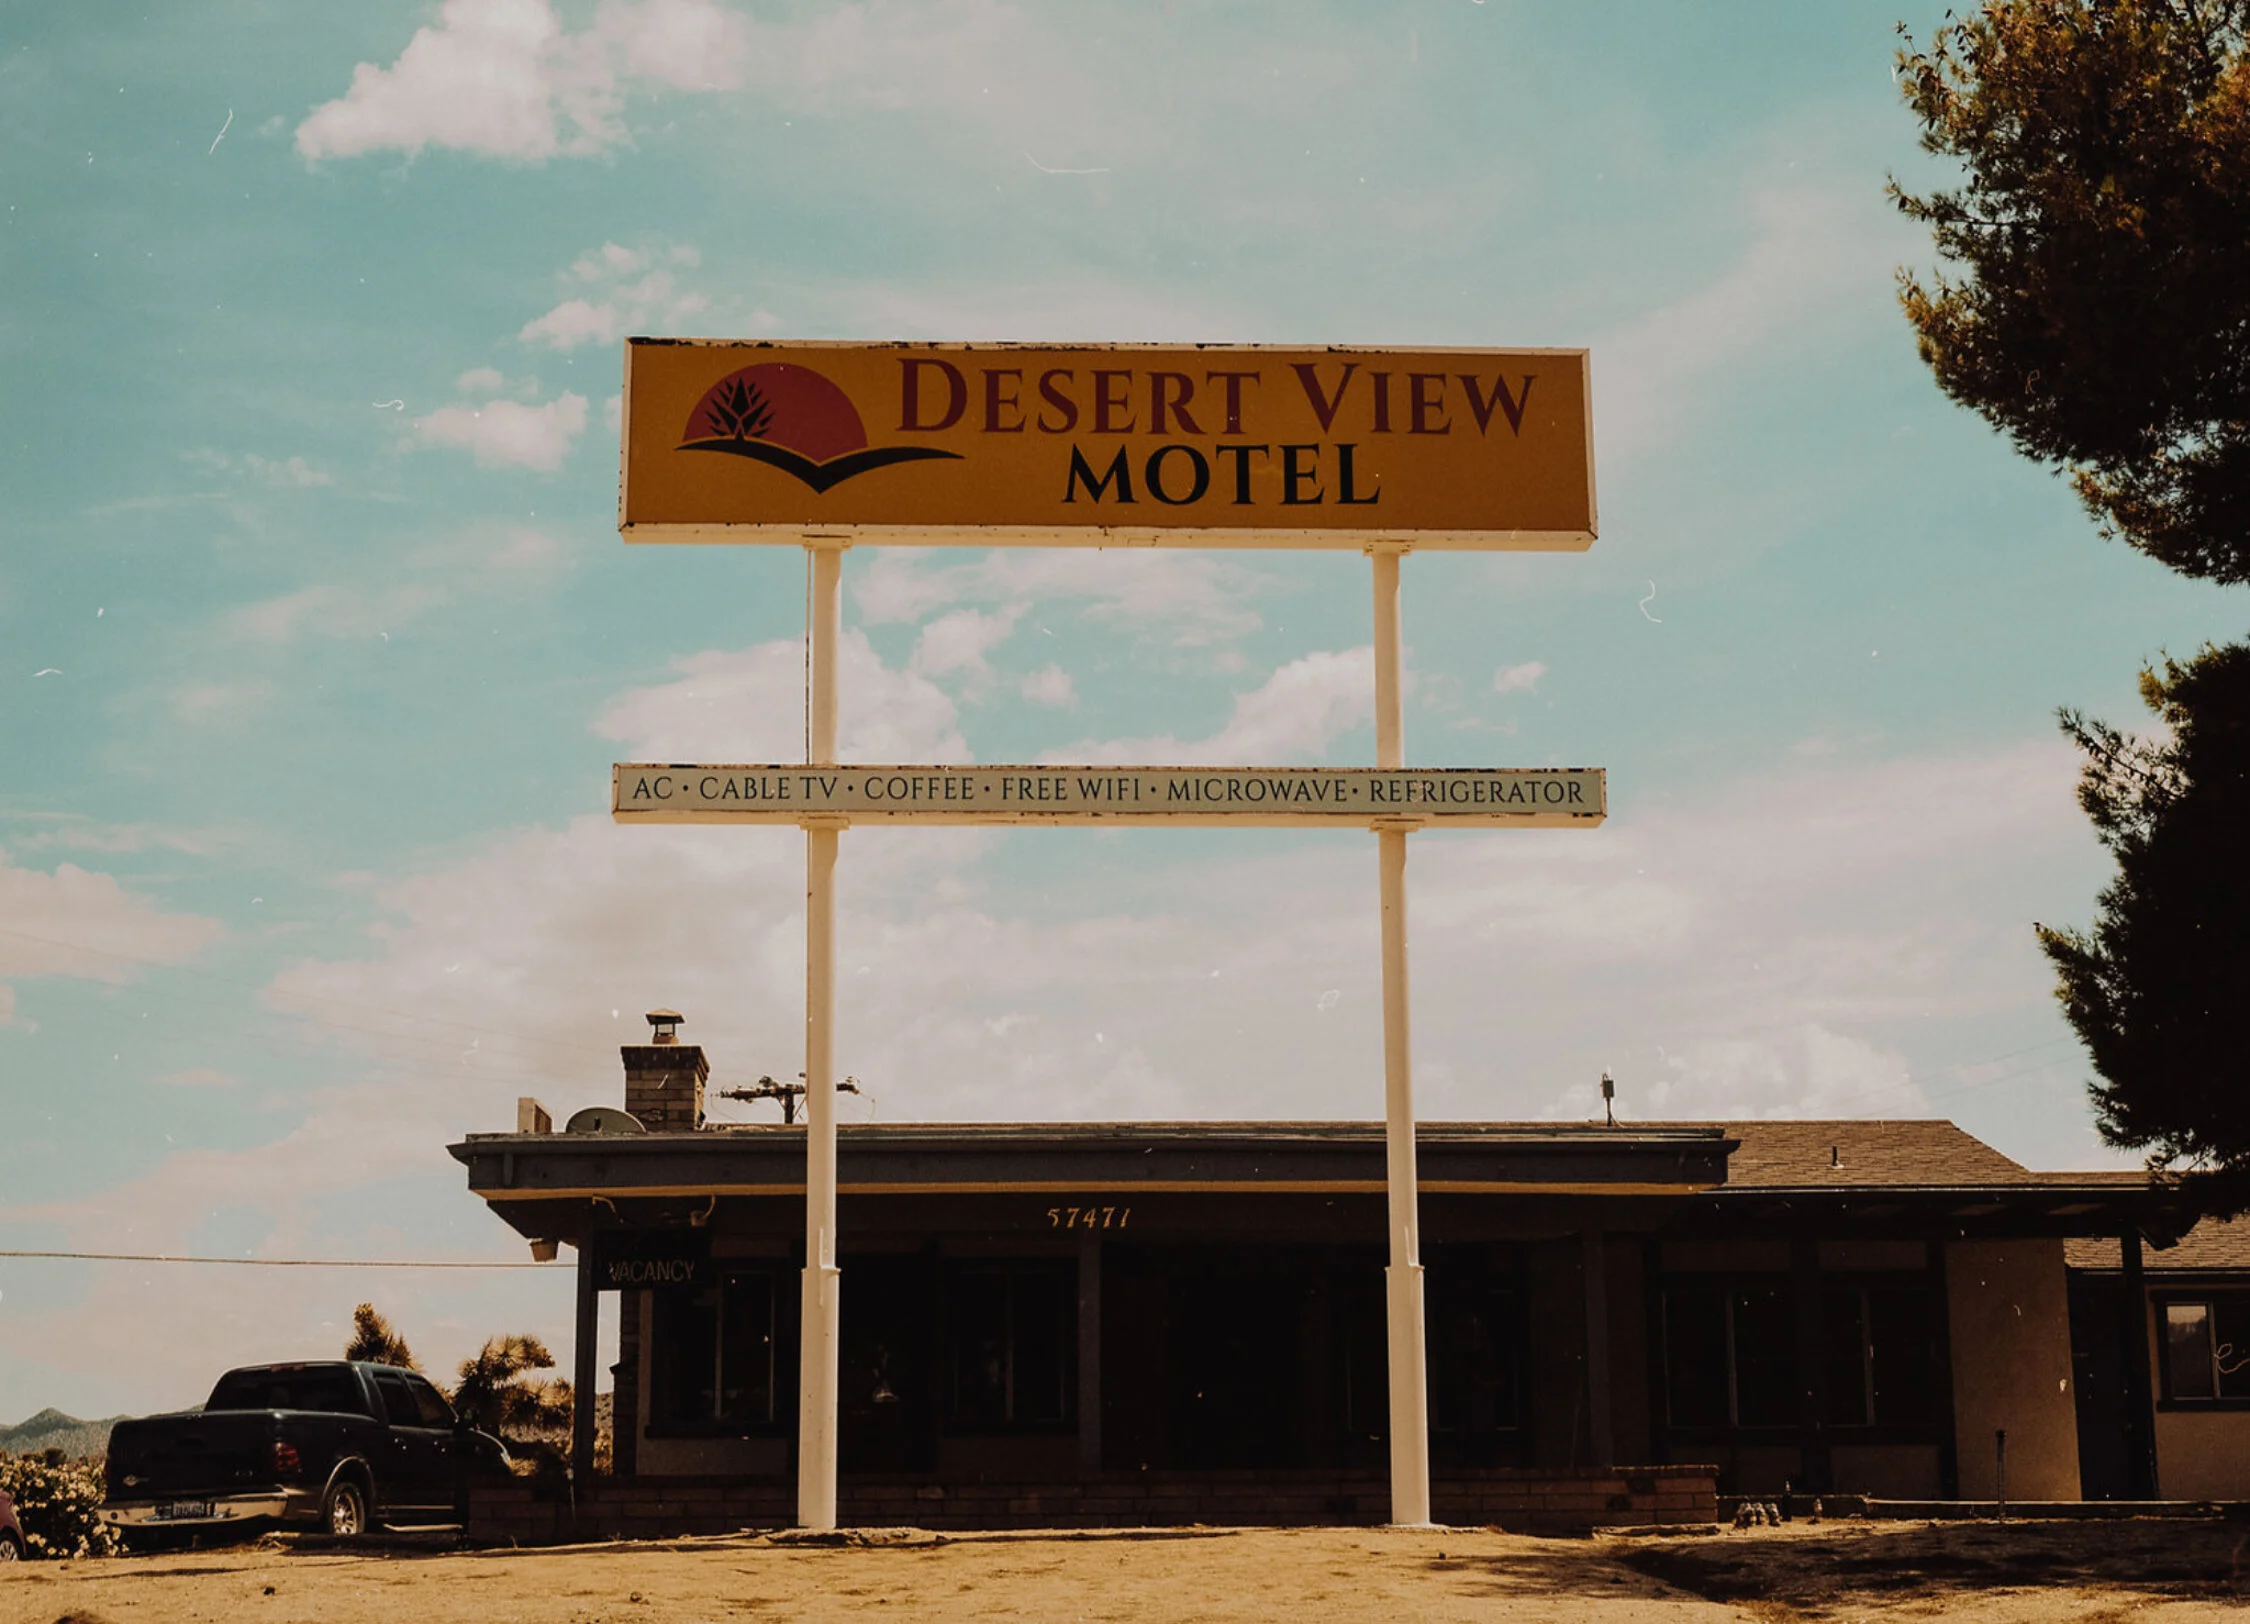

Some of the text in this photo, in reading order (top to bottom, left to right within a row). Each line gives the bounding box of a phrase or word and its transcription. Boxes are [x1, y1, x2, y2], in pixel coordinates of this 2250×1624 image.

[895, 357, 1537, 438] DESERT VIEW
[1061, 442, 1382, 507] MOTEL
[632, 776, 1584, 805] AC CABLE TV COFFEE FREE WIFI MICROWAVE REFRIGERATOR
[1046, 1206, 1131, 1229] 57471
[608, 1259, 696, 1282] VACANCY
